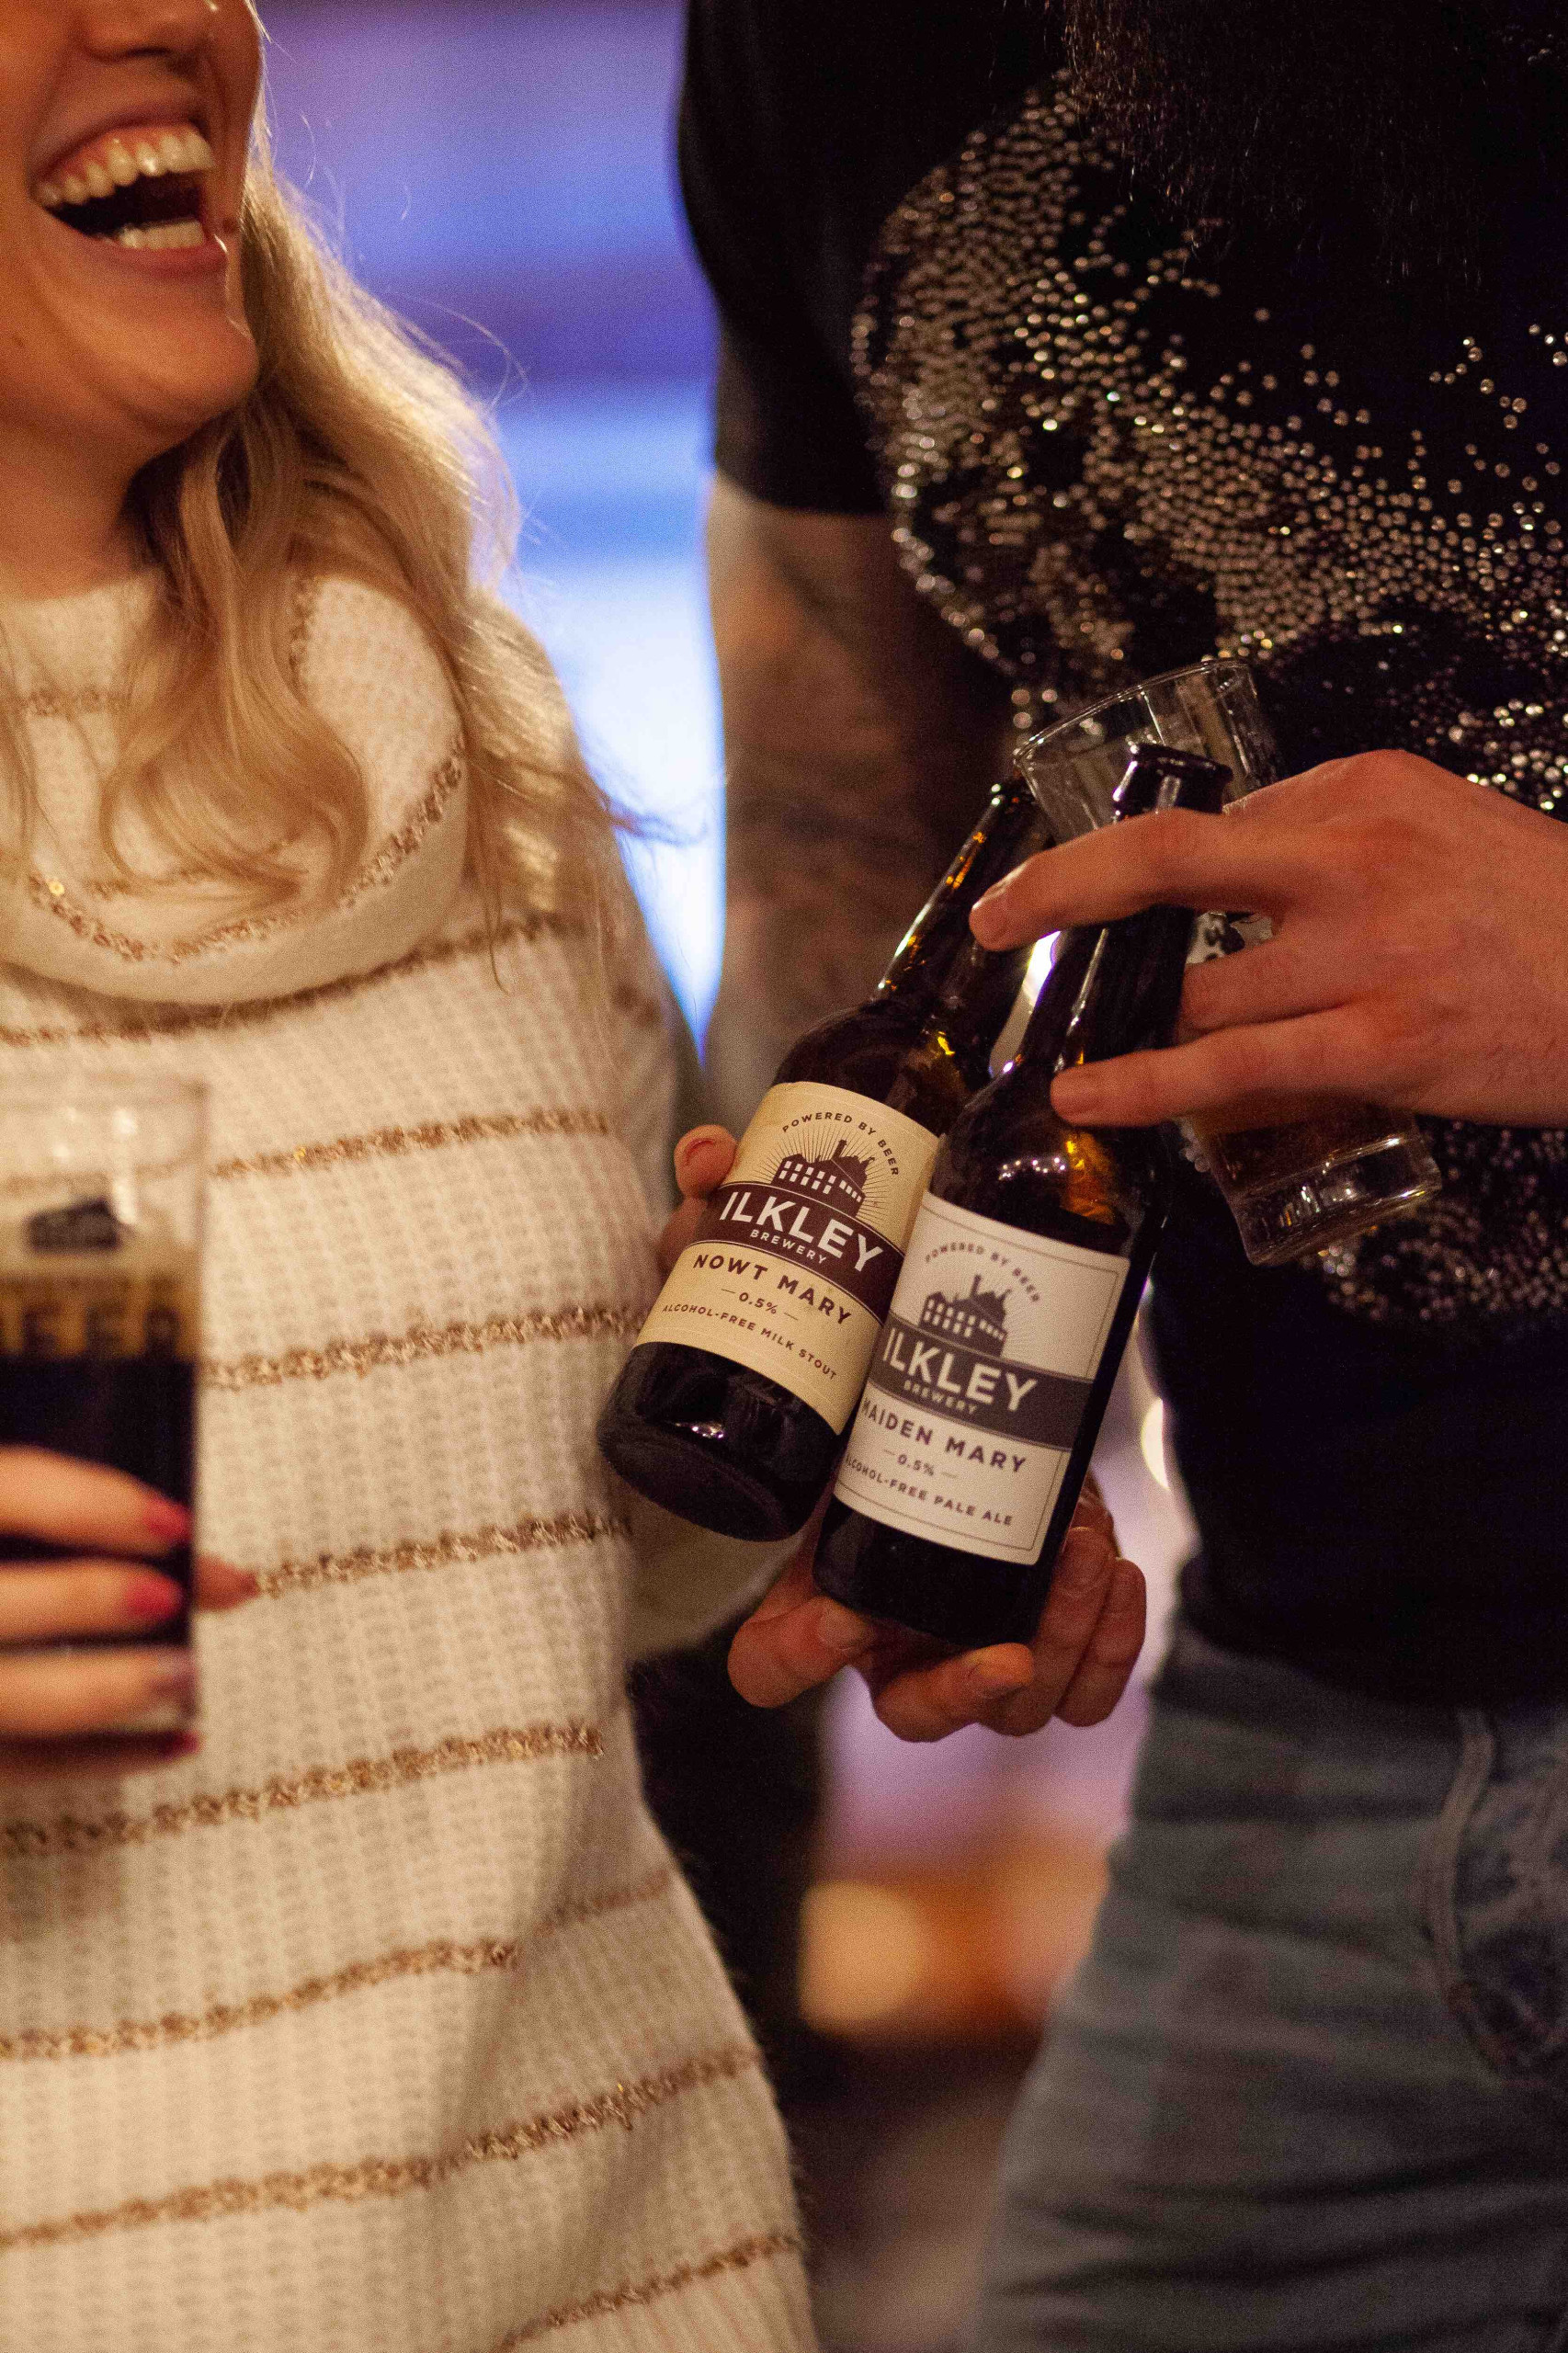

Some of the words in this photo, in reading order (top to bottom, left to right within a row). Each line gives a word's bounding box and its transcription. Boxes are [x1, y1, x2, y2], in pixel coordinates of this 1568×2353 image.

[782, 1111, 853, 1133] POWERED
[858, 1121, 877, 1137] BY
[877, 1138, 900, 1176] BEER
[720, 1191, 884, 1272] ILKLEY
[749, 1229, 827, 1265] BREWERY
[693, 1254, 768, 1282] NOWT
[777, 1275, 853, 1325] MARY
[738, 1291, 778, 1315] 0.5%
[926, 1241, 984, 1264] POWERED
[991, 1252, 1010, 1267] BY
[1012, 1267, 1042, 1303] BEER
[661, 1303, 756, 1331] ALCOHOL-FREE
[760, 1327, 795, 1349] MILK
[799, 1348, 837, 1381] STOUT
[882, 1327, 1039, 1411] ILKLEY
[903, 1380, 978, 1415] BREWERY
[860, 1396, 934, 1446] MAIDEN
[945, 1436, 1027, 1472] MARY
[897, 1453, 935, 1477] 0.5%
[934, 1495, 976, 1517] PALE
[982, 1510, 1014, 1526] ALE
